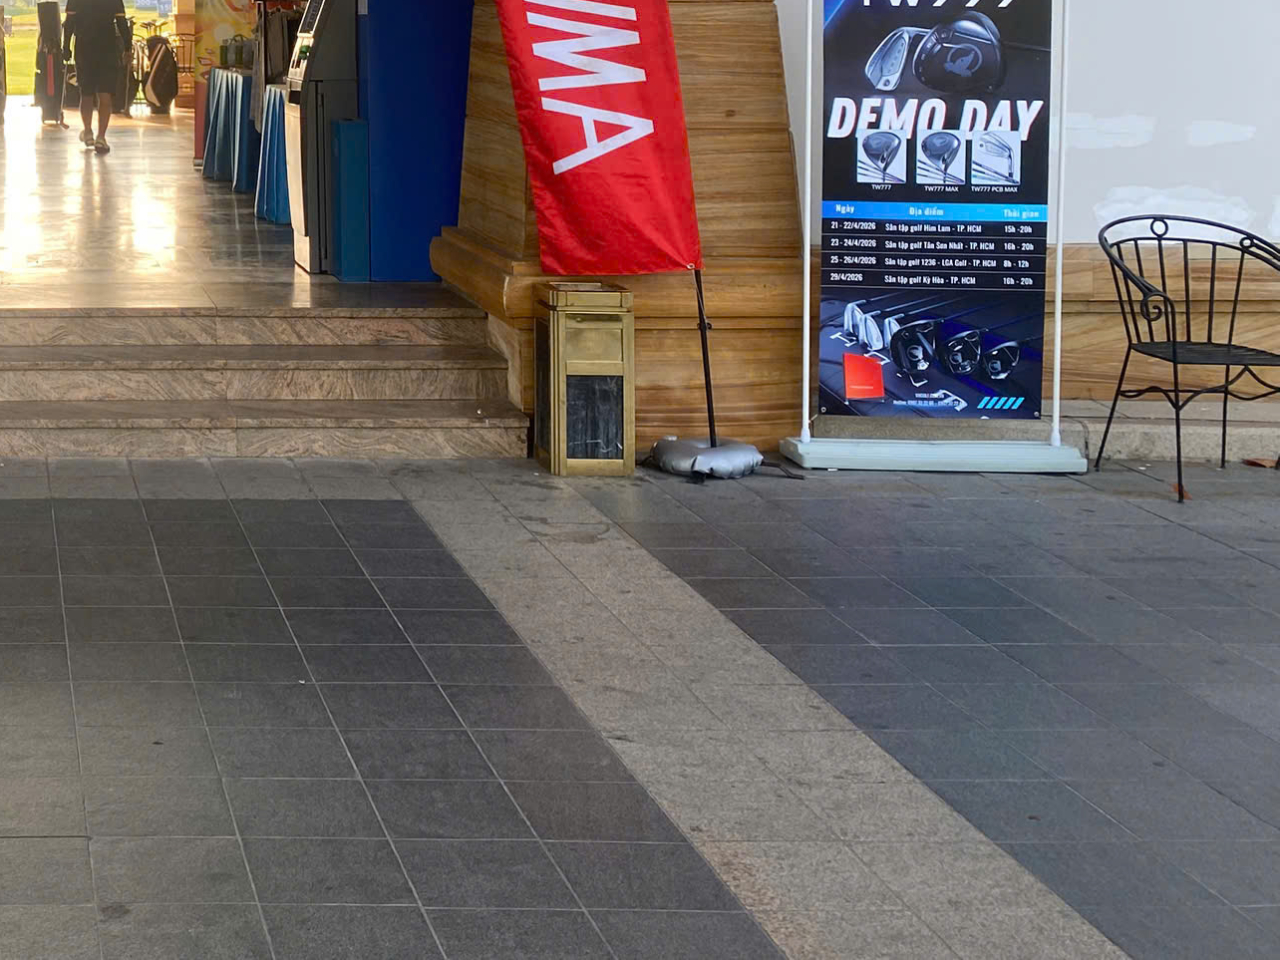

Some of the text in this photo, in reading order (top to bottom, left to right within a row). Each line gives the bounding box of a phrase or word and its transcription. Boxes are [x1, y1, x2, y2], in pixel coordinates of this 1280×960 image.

[827, 97, 1044, 142] DEMO DAY
[835, 204, 855, 214] Ngày
[967, 224, 982, 233] HCM
[979, 242, 995, 250] HCM
[961, 276, 976, 285] HCM
